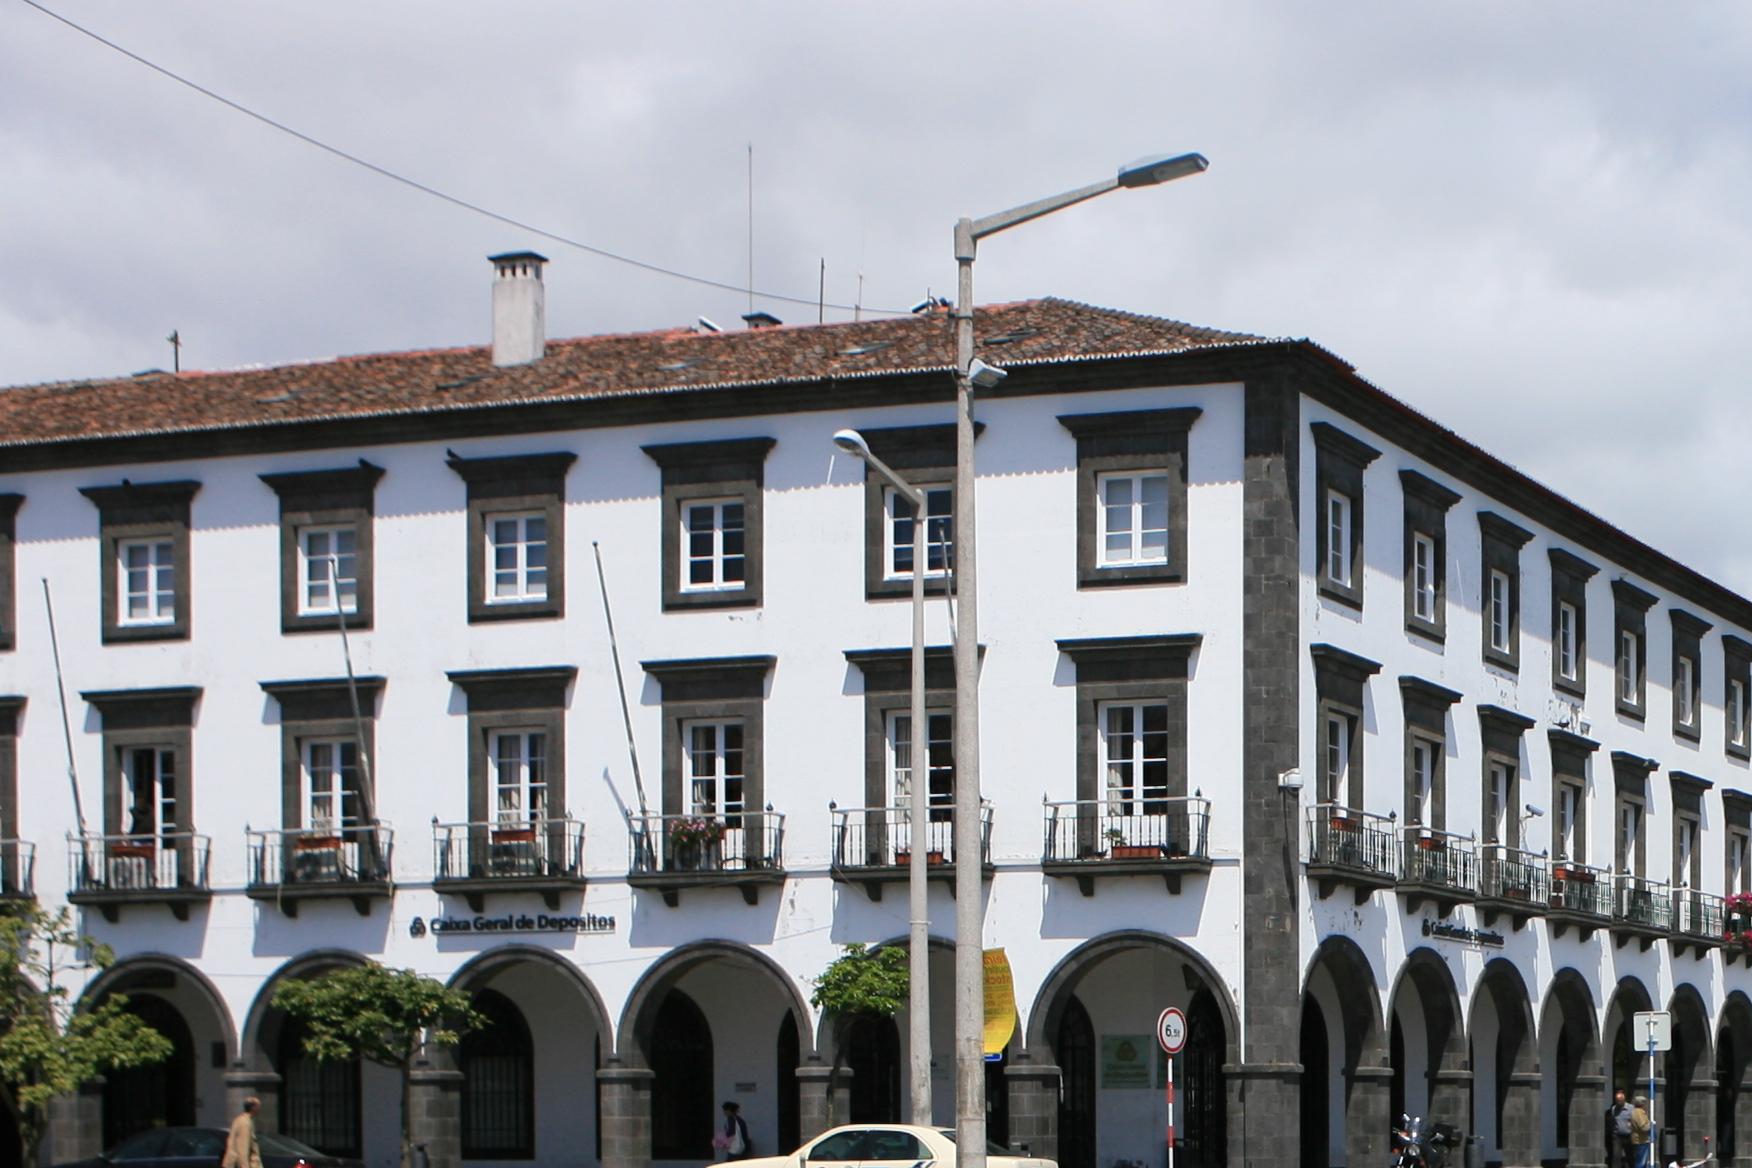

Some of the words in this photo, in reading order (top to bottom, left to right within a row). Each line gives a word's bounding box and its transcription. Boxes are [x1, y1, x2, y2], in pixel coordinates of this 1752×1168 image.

[430, 917, 471, 932] Caixa
[473, 915, 513, 931] Geral
[515, 914, 534, 930] de
